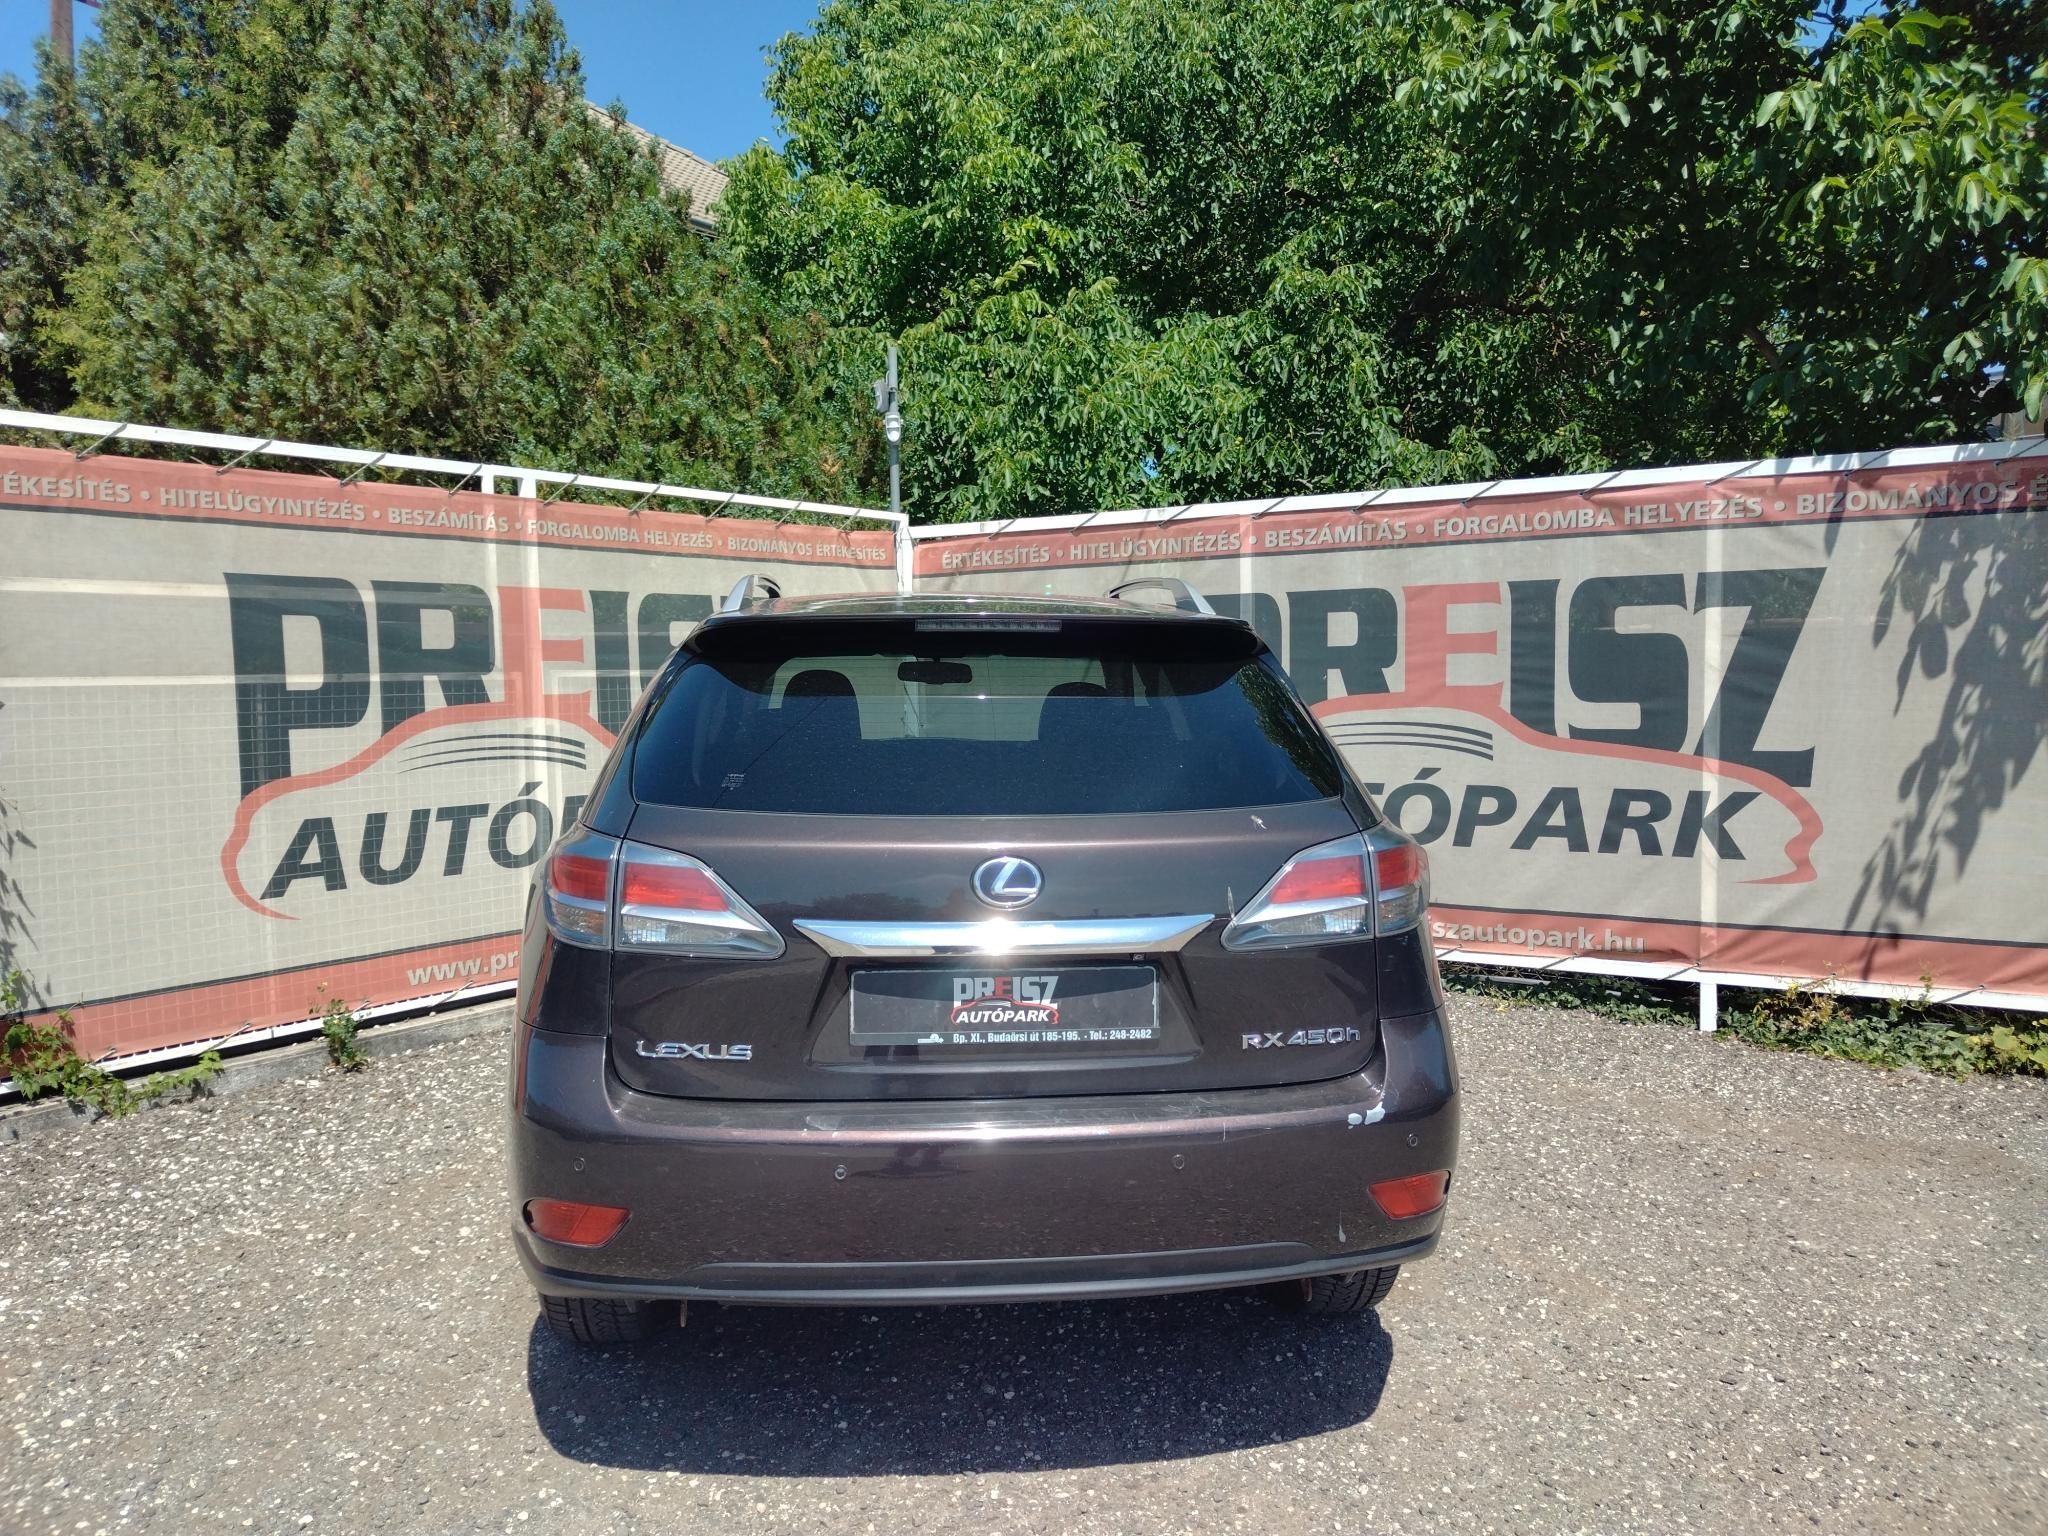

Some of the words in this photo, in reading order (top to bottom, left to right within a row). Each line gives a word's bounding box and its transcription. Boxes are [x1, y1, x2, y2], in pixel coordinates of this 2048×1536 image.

[159, 486, 366, 521] HITELÜGYINTÉZÉS
[388, 504, 509, 533] BESZÁMÍTÁS
[527, 519, 640, 545] FORGALOMBA
[644, 529, 713, 549] HELYEZÉS
[727, 536, 813, 556] BIZOMÁNYOS
[816, 539, 887, 561] ÉRTÉKESÍTÉS
[941, 544, 1050, 570] ÉRTÉKESÍTÉS
[1069, 531, 1241, 561] HITELÜGYINTÉZÉS
[1264, 520, 1408, 548] BESZÁMÍTÁS
[1433, 511, 1616, 538] FORGALOMBA
[1624, 494, 1763, 526] HELYEZÉS
[1796, 480, 2019, 517] BIZOMÁNYOS
[1428, 915, 1645, 953] szautopark.hu
[407, 950, 520, 986] www.pr
[953, 975, 1059, 1008] PREISZ
[956, 1007, 1050, 1023] AUTÓPARK
[636, 1040, 753, 1061] LEXUS
[953, 1033, 968, 1044] Bp.
[988, 1032, 1028, 1042] Budaörsi
[1030, 1031, 1040, 1041] út
[1042, 1031, 1081, 1041] 185-195.
[1090, 1030, 1108, 1040] Tel.:
[1110, 1029, 1152, 1040] 248-2482
